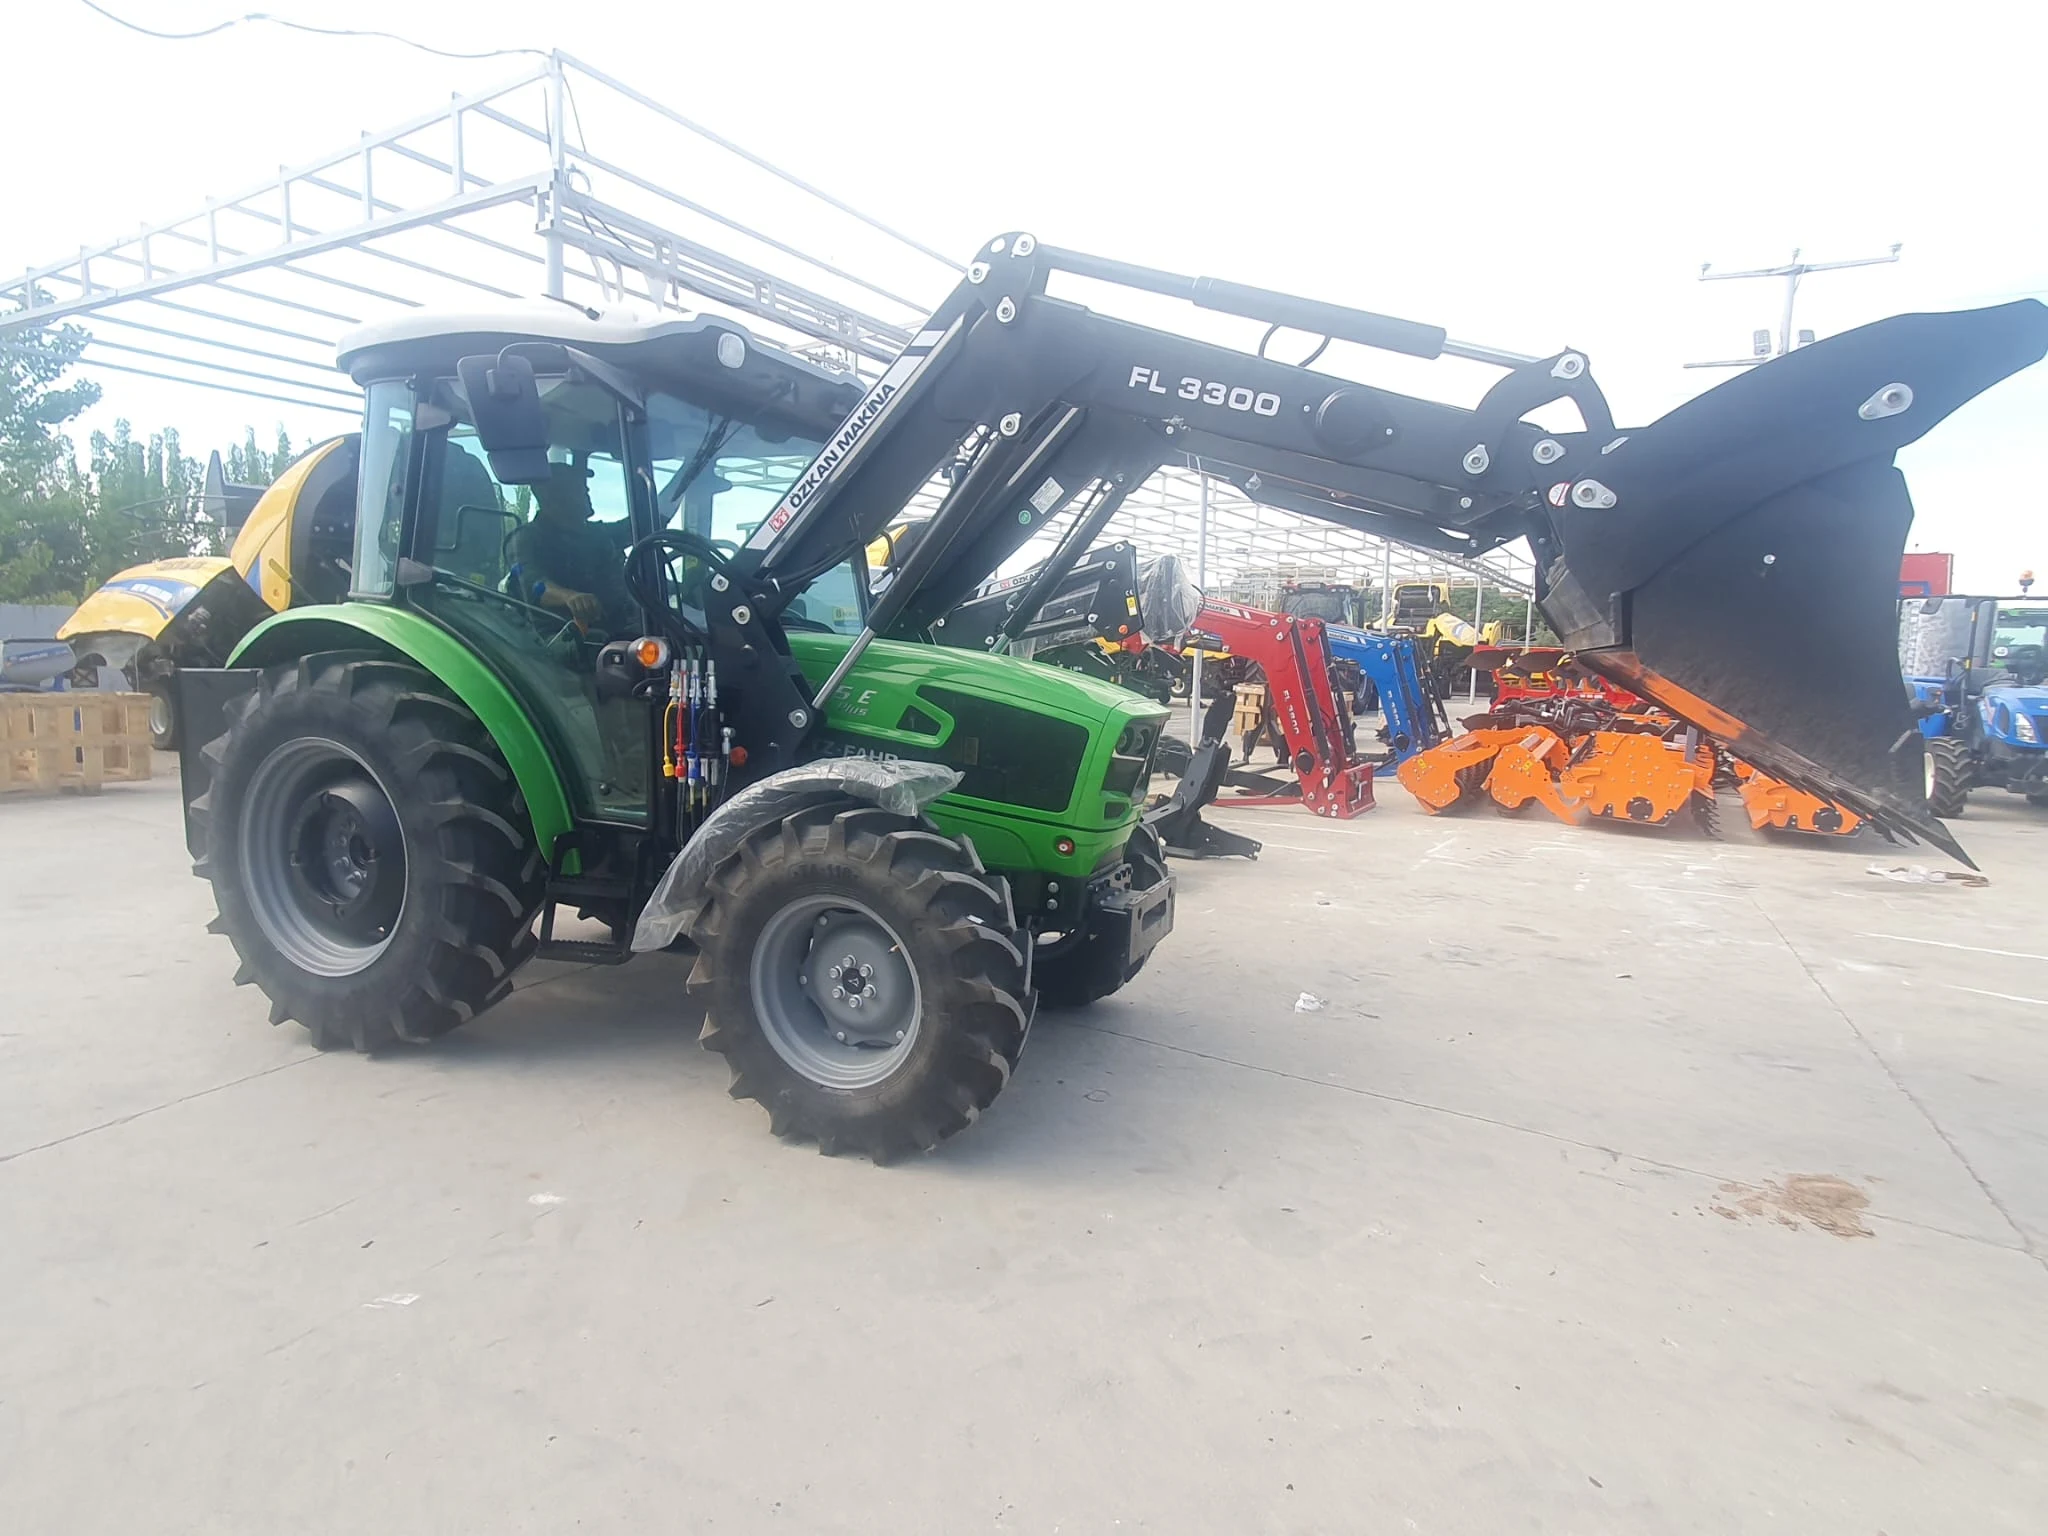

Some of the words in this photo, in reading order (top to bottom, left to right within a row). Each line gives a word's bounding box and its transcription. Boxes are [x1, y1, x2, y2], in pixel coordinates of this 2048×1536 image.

[1128, 365, 1167, 394] FL
[1177, 376, 1281, 417] 3300
[789, 449, 839, 508] ÖZKAN
[836, 383, 896, 452] MAKİNA
[857, 689, 879, 705] E
